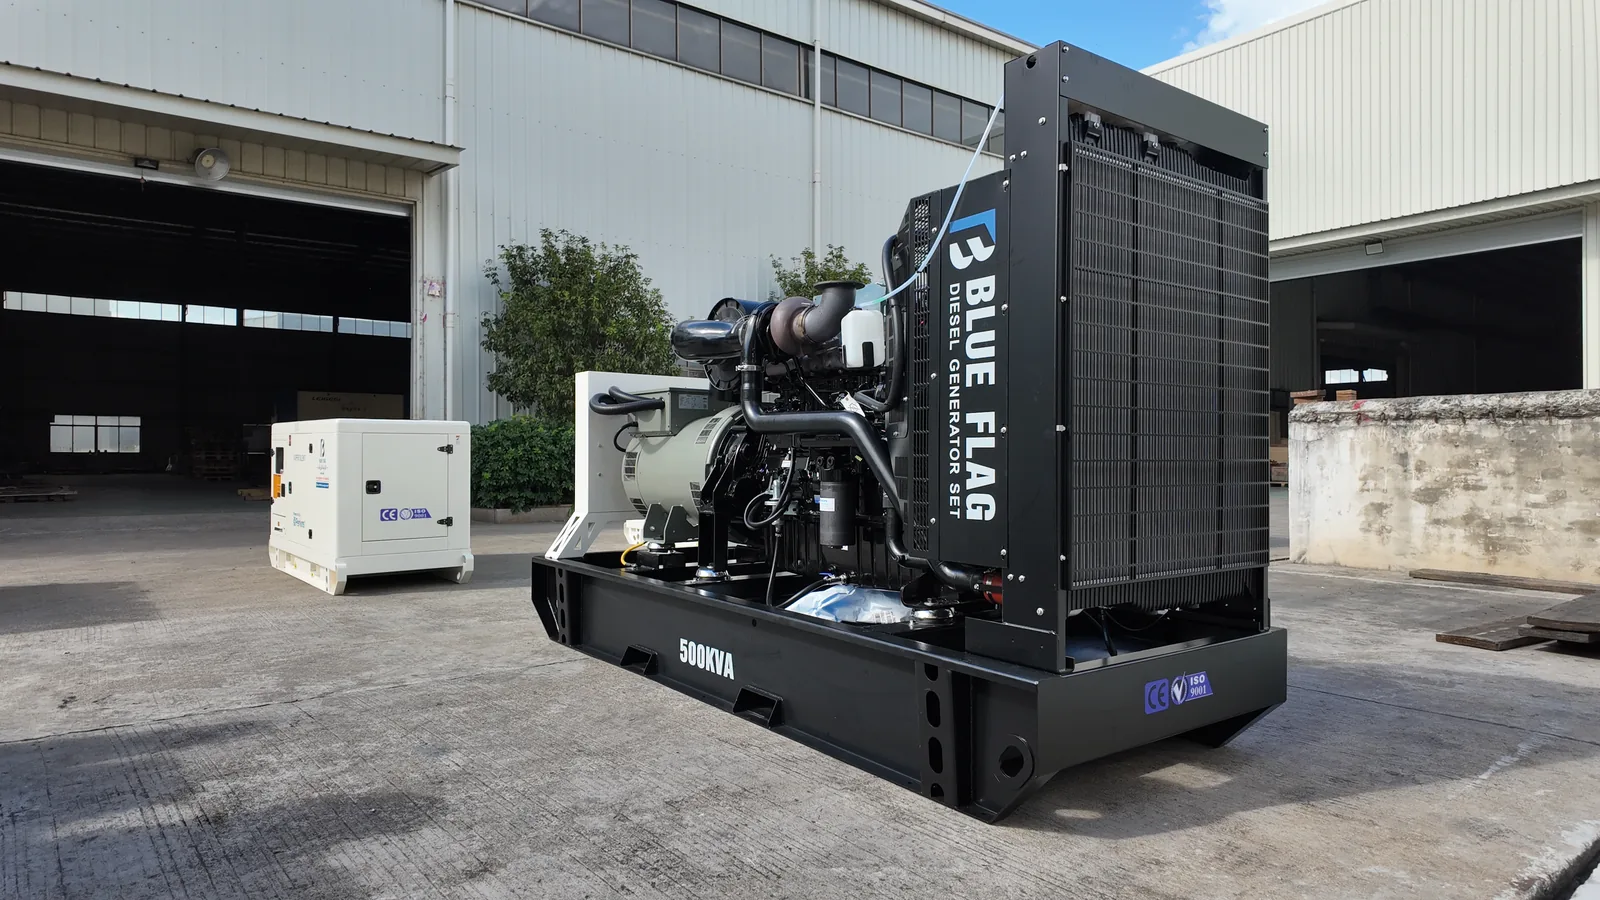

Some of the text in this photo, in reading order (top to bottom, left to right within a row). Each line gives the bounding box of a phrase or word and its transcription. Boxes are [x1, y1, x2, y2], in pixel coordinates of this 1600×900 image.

[949, 282, 961, 519] DIESEL GENERATOR SET
[965, 274, 996, 521] BLUE FLAG
[382, 509, 396, 520] CE
[679, 637, 735, 681] 500KVA
[1190, 674, 1205, 686] ISO
[1190, 685, 1207, 697] 9001
[1148, 682, 1166, 710] CE
